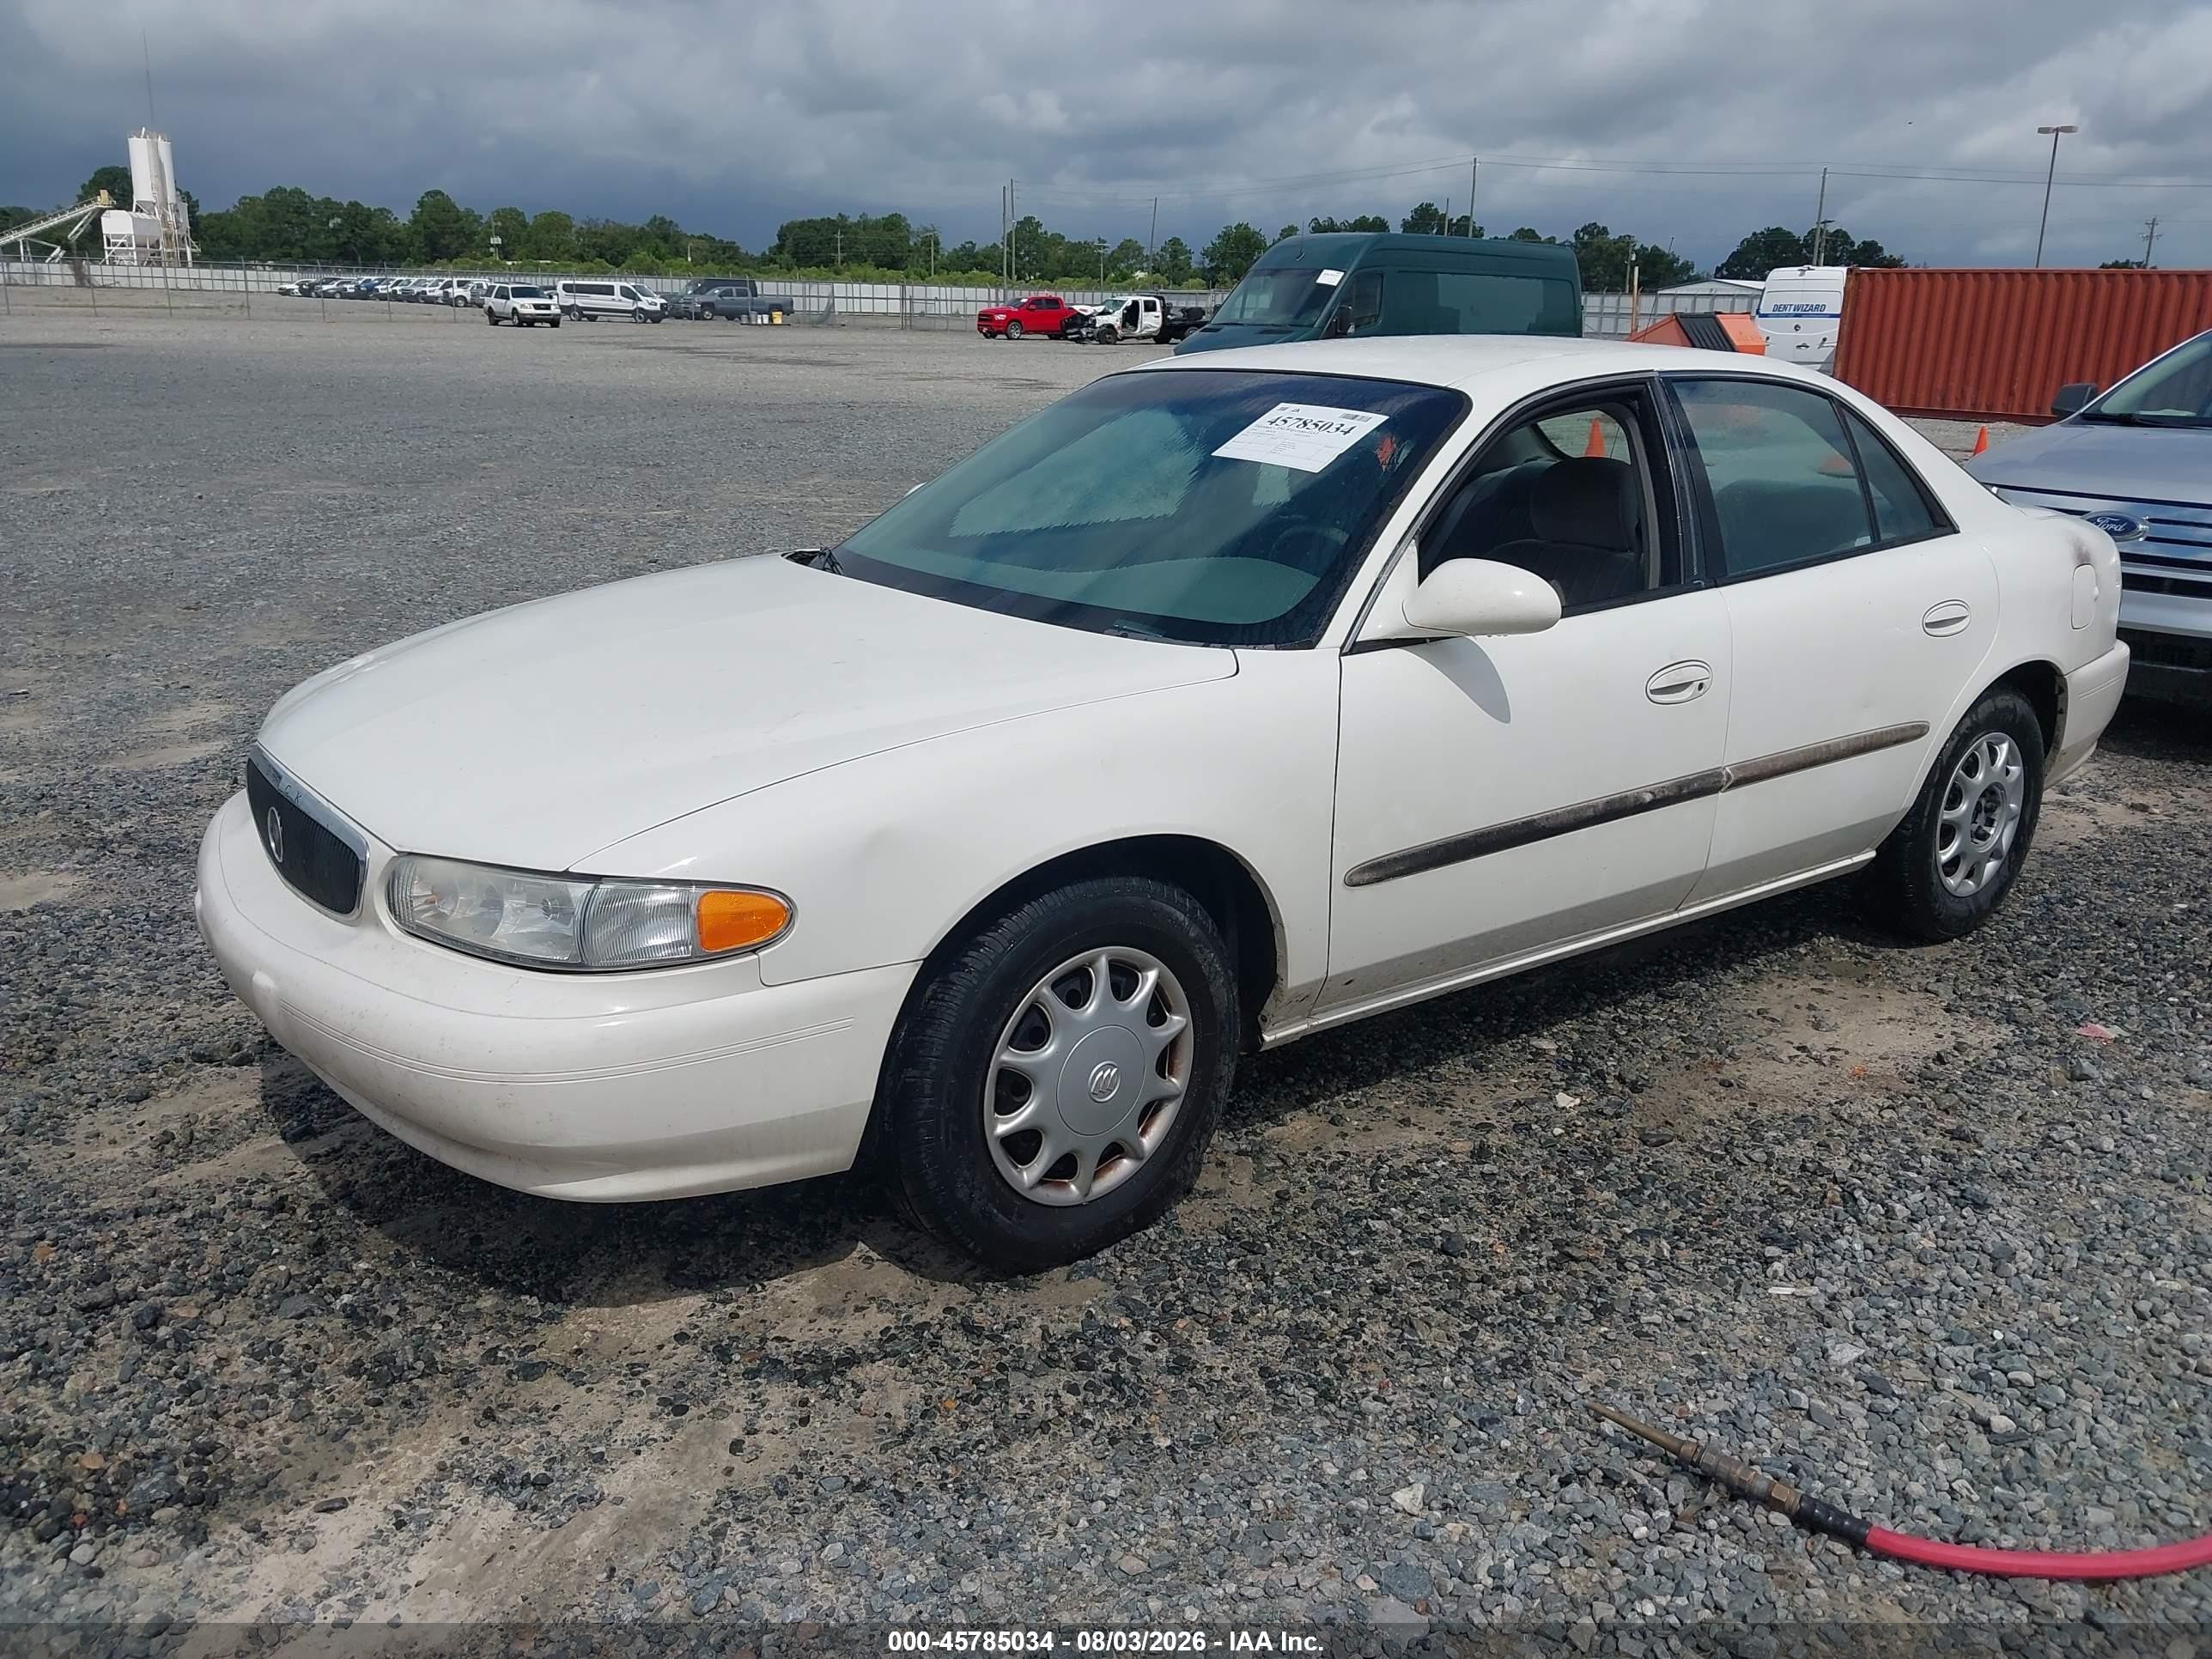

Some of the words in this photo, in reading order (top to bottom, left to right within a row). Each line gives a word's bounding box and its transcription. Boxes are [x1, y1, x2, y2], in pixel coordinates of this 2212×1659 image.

[1771, 303, 1793, 313] DENT
[1793, 303, 1826, 313] WIZARD
[1267, 416, 1358, 436] 45785034
[2095, 517, 2127, 532] Ford
